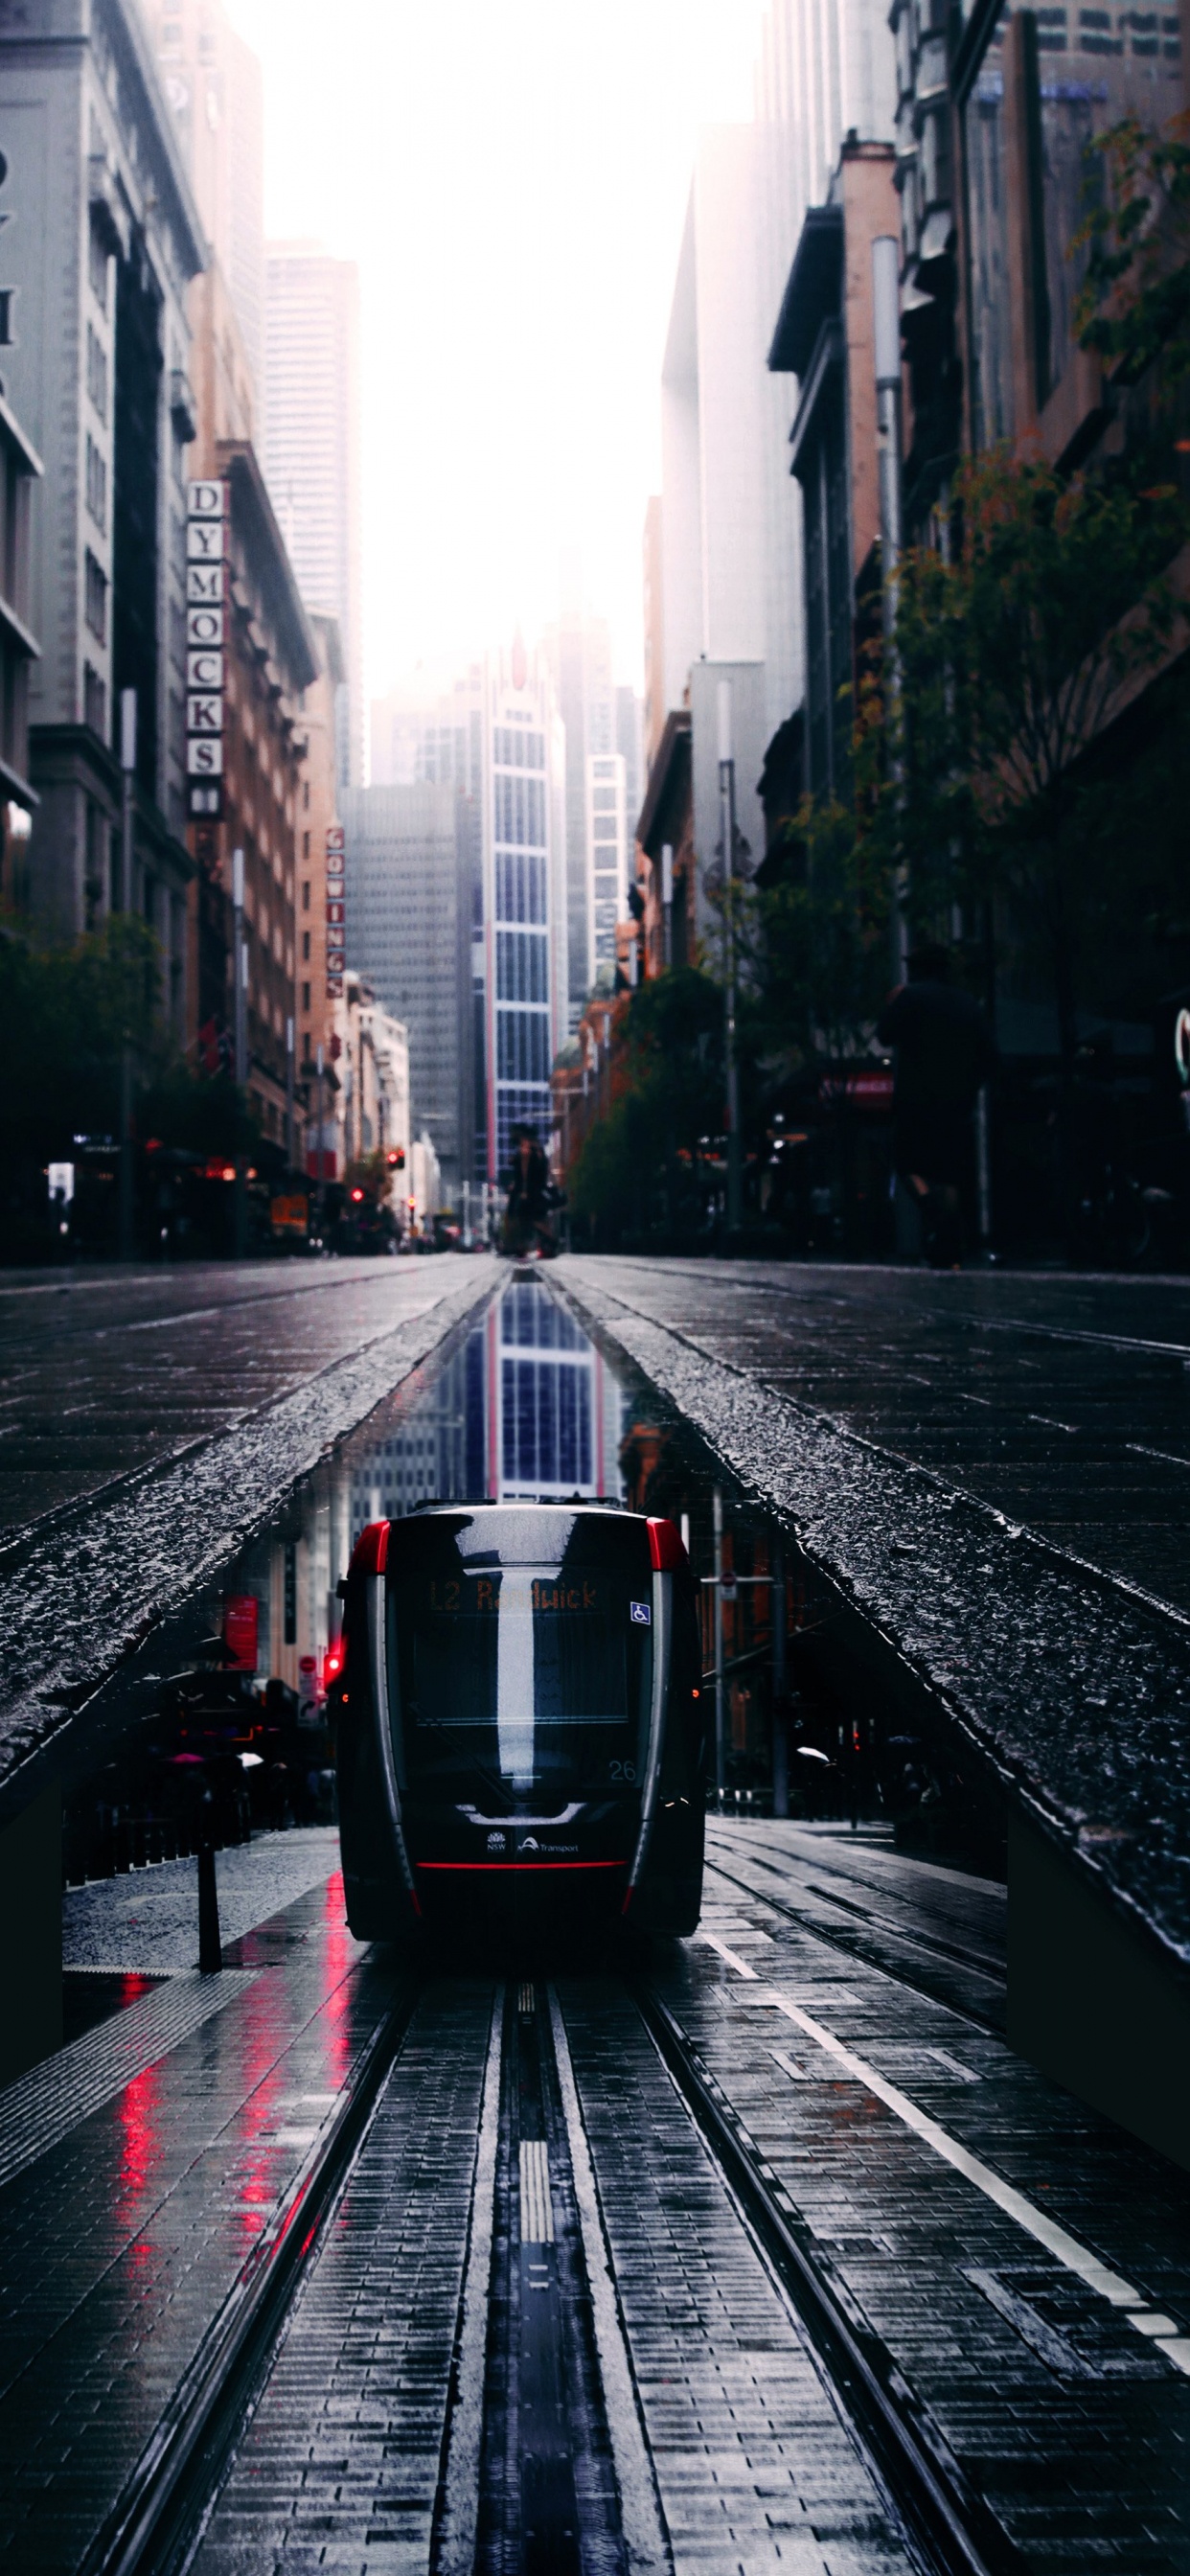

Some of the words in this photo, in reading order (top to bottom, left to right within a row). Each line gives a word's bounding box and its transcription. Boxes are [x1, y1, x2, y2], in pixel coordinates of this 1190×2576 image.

[191, 488, 218, 772] DYMOCKS
[327, 830, 343, 996] GOWINGS
[430, 1581, 461, 1611] L2
[608, 1760, 636, 1782] 26
[539, 1843, 579, 1852] Transport
